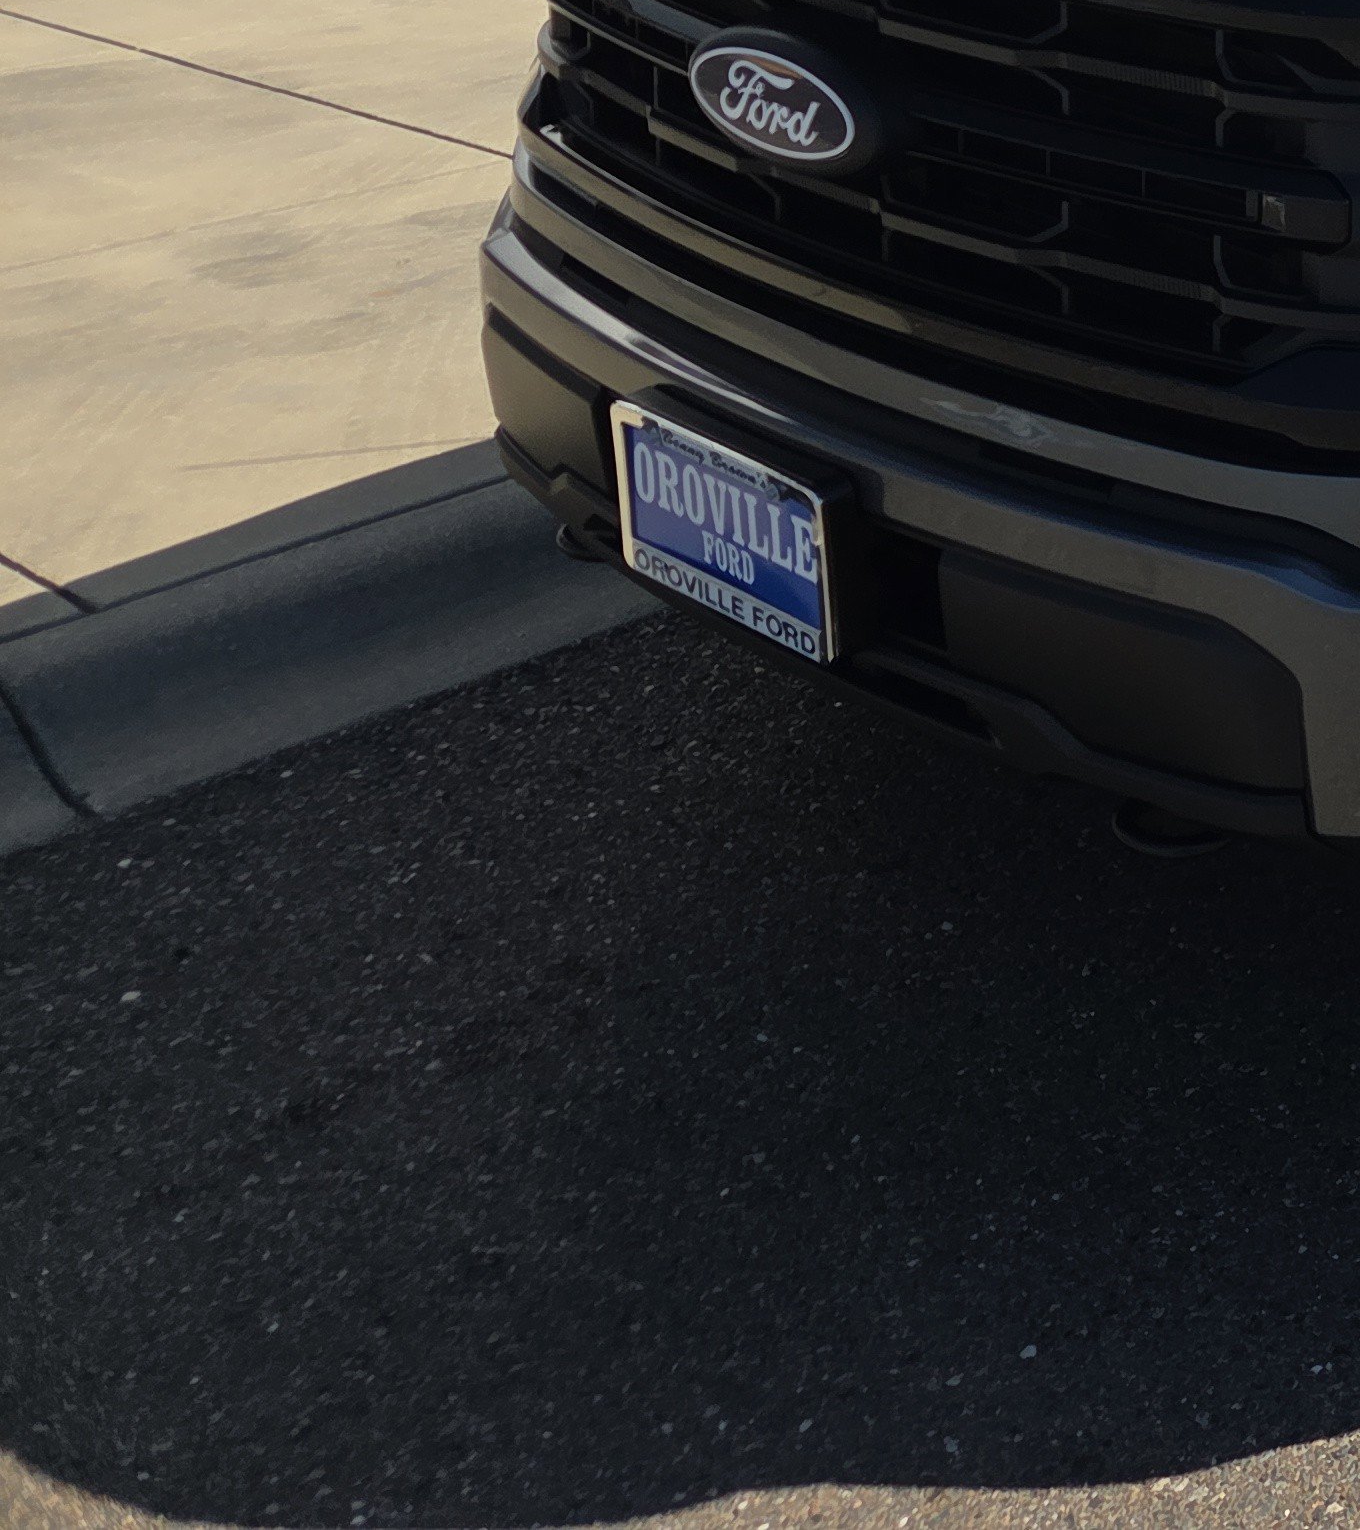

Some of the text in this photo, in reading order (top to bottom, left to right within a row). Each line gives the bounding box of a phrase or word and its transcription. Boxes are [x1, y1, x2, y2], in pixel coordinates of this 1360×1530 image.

[720, 59, 822, 146] Ford
[633, 442, 818, 585] OROVILLE
[701, 530, 755, 586] FORD
[634, 547, 817, 655] OROVILLE FORD
